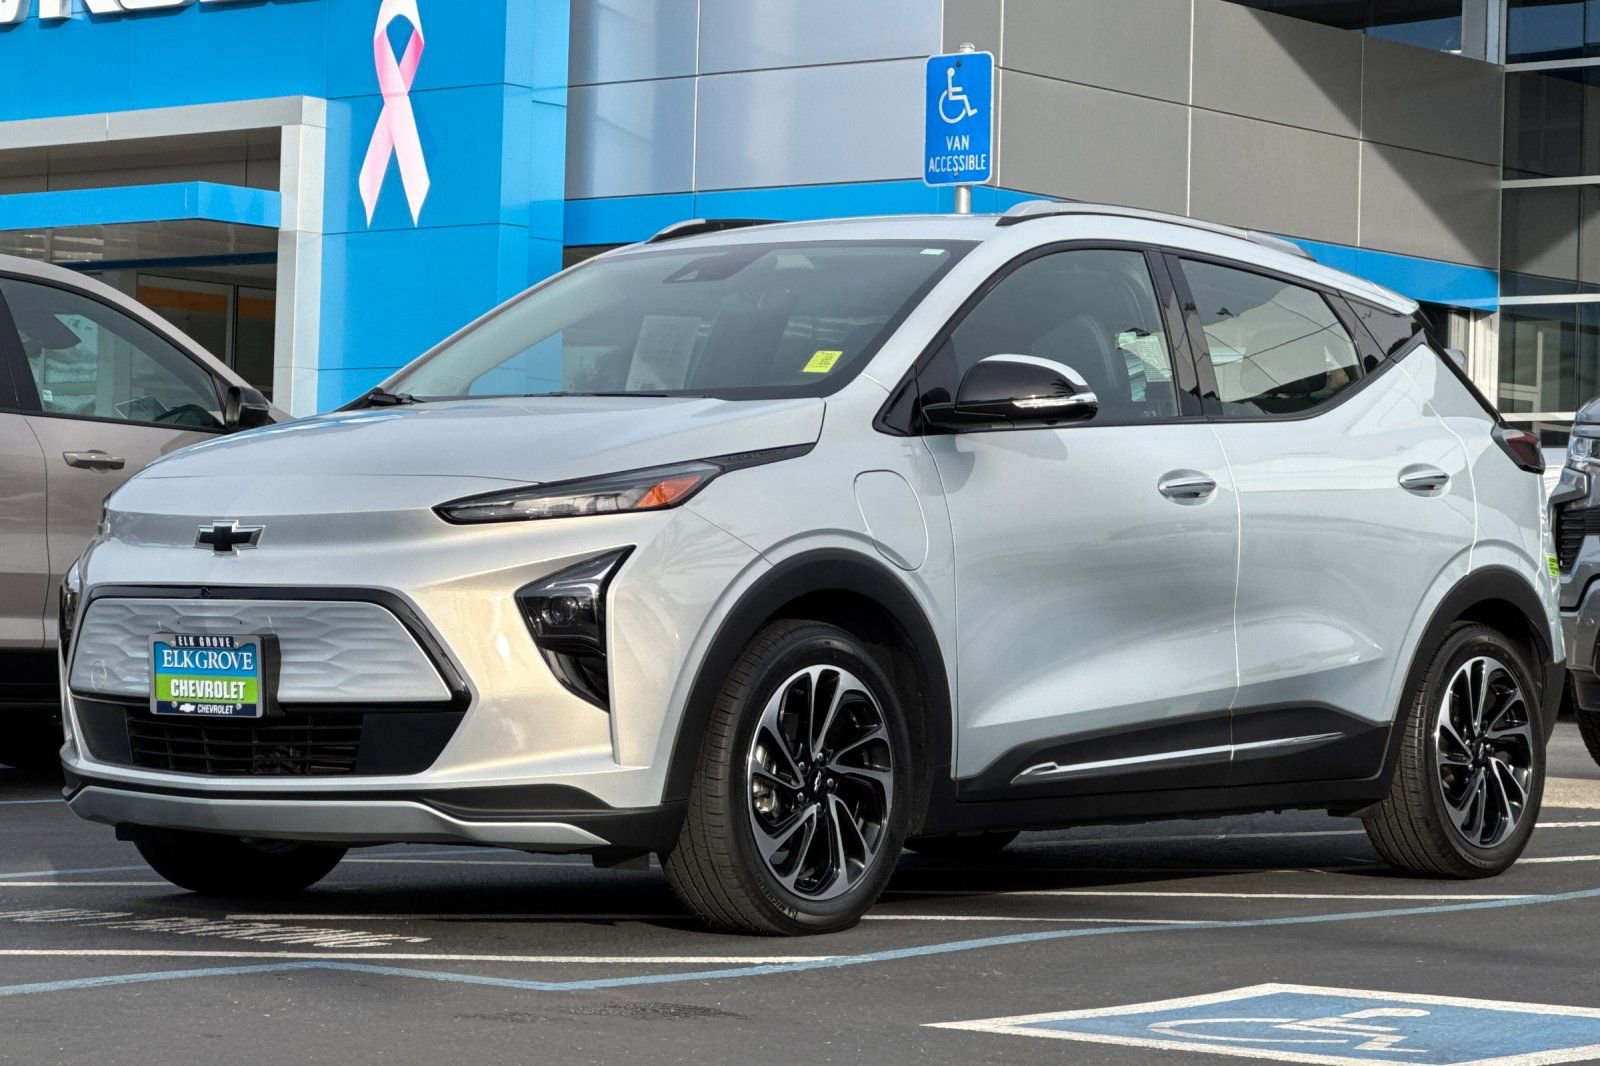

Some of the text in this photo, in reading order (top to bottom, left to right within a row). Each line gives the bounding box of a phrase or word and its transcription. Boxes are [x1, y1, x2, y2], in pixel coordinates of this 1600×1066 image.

[946, 135, 969, 151] VAN
[928, 153, 987, 172] ACCESSIBLE
[178, 636, 231, 648] ELK GROVE
[170, 679, 246, 700] CHEVROLET
[197, 704, 234, 715] CHEVROLET
